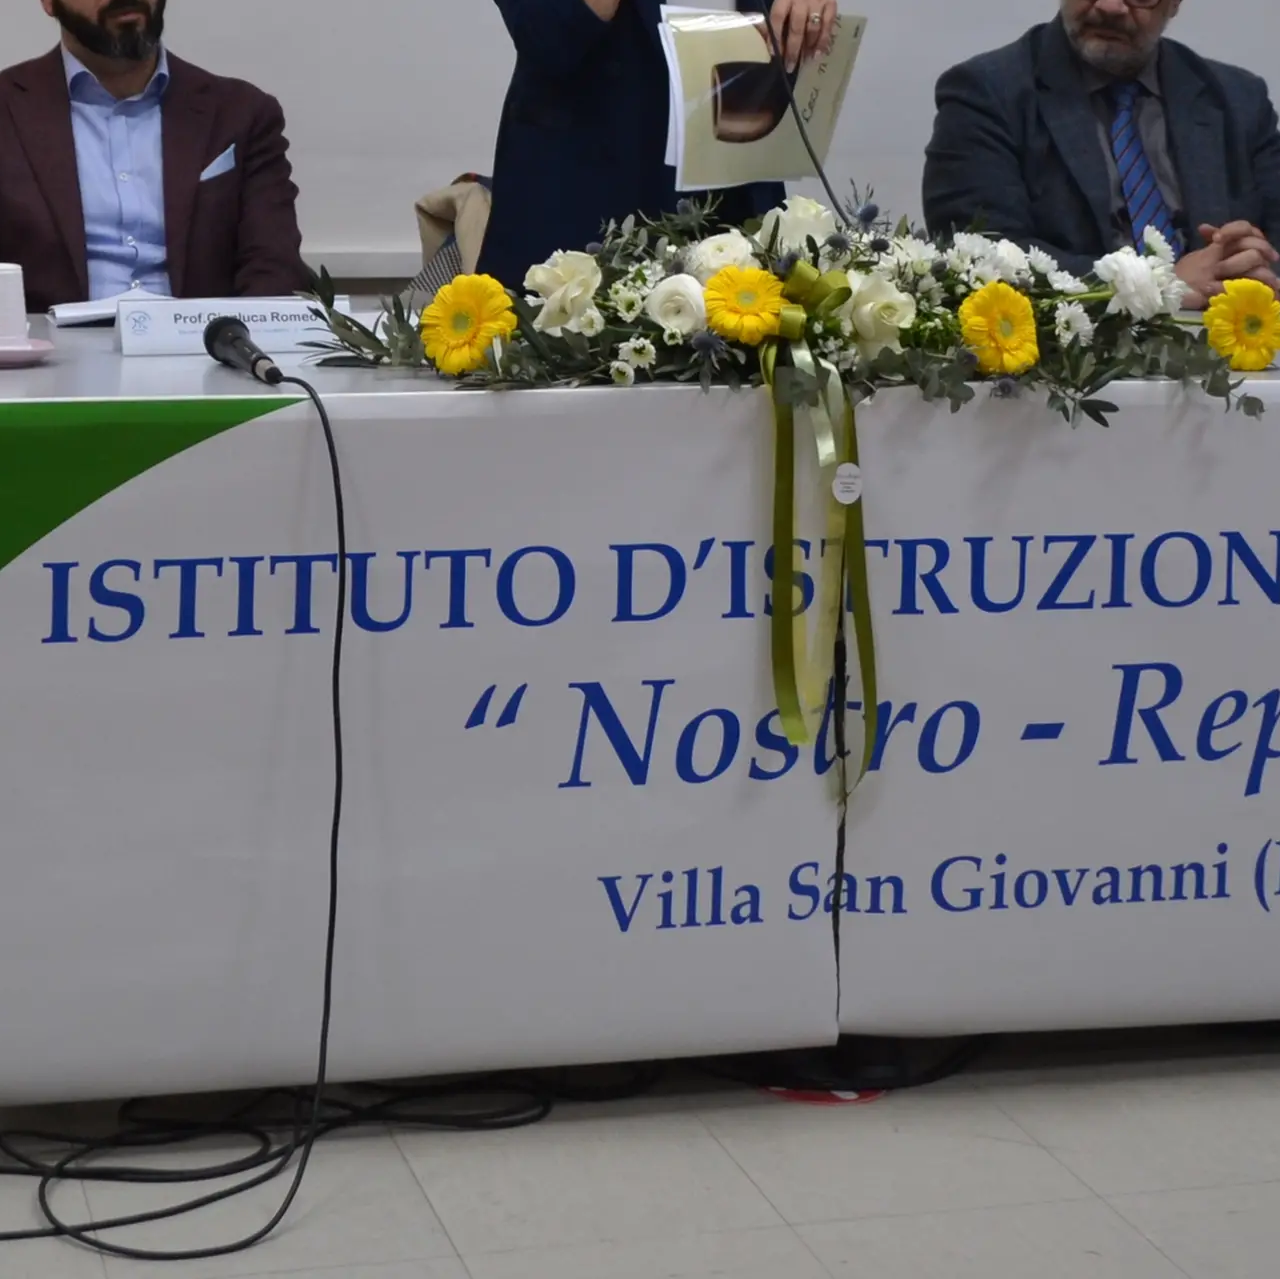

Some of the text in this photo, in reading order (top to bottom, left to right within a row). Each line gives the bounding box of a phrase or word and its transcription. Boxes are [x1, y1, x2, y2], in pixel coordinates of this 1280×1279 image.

[271, 311, 319, 323] Romeo
[40, 546, 578, 644] ISTITUTO
[558, 678, 982, 789] Nostro
[598, 866, 765, 933] Villa
[787, 861, 908, 922] San
[929, 842, 1231, 912] Giovanni
